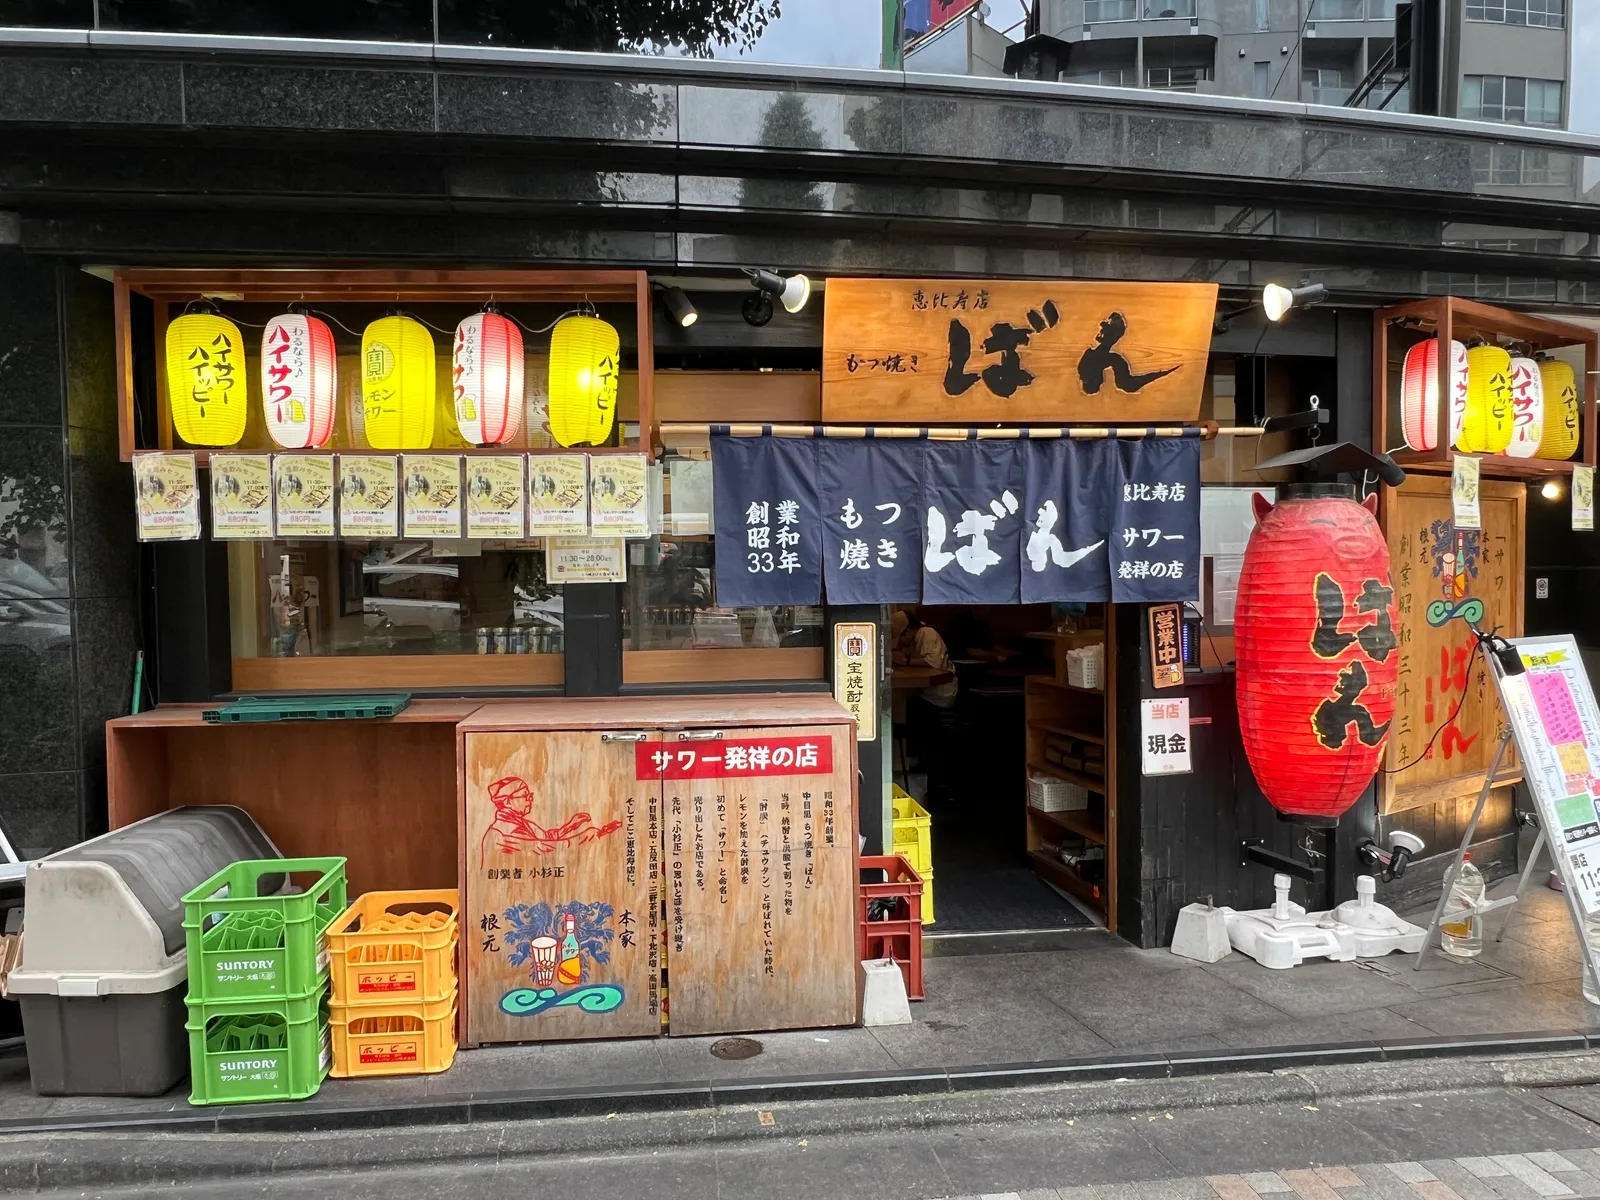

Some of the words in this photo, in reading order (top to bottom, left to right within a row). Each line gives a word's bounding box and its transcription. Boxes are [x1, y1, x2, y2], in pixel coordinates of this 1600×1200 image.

[912, 289, 989, 310] 恵比寿店
[846, 353, 918, 373] もつ焼き
[942, 299, 1184, 399] ばん
[188, 346, 213, 418] ハイッピー
[212, 333, 235, 404] ハイサワー
[268, 324, 293, 423] ハイサワー
[597, 355, 614, 426] ハイッピー
[1489, 371, 1507, 431] ハイッピー
[1512, 365, 1534, 442] ハイサワー
[1561, 386, 1576, 441] ハイッピー
[746, 500, 800, 525] 創業
[840, 497, 902, 529] もつ
[747, 526, 801, 550] 昭和
[923, 489, 1105, 575] ばん
[1122, 527, 1185, 548] サワー
[747, 550, 801, 575] 33年
[1118, 560, 1184, 579] 発祥の店
[1155, 611, 1177, 664] 営業中
[1398, 533, 1412, 767] 創業昭和三十三年
[1151, 703, 1180, 720] 当店
[1440, 633, 1480, 762] ばん
[650, 742, 819, 772] サワー発祥の店
[1147, 733, 1187, 755] 現金
[487, 868, 523, 880] 創業者
[529, 866, 565, 879] 小杉正
[480, 913, 501, 953] 根元
[618, 908, 636, 949] 本家
[216, 960, 275, 971] SUNTORY
[219, 1059, 277, 1071] SUNTORY
